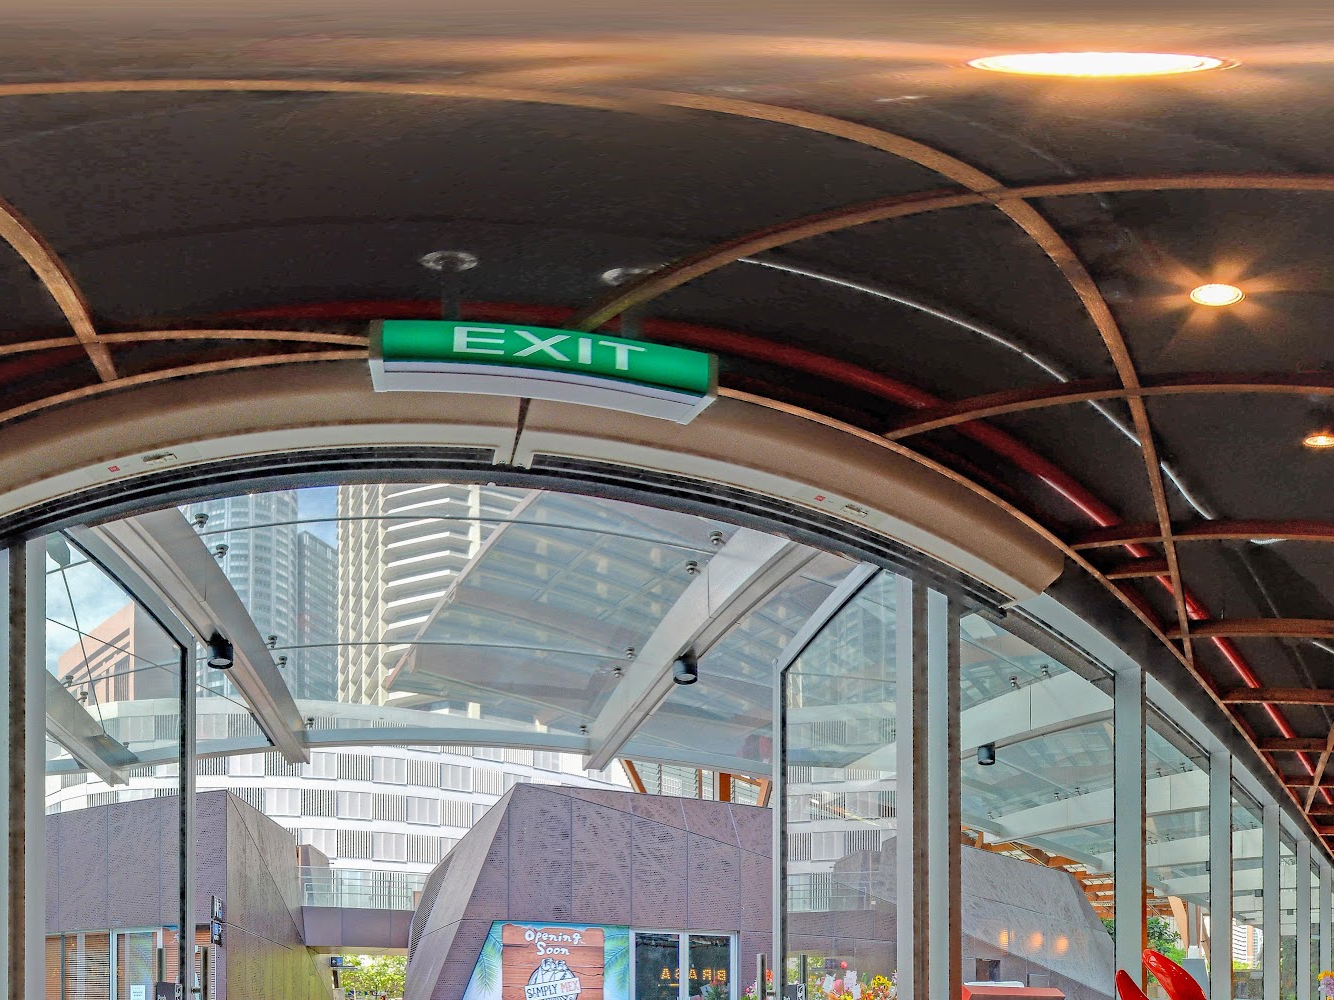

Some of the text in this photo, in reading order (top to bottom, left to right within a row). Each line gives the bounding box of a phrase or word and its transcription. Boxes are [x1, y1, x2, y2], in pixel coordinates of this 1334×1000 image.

[452, 326, 647, 371] EXIT
[524, 929, 586, 944] Opening
[536, 941, 570, 956] Soon
[526, 980, 580, 999] SIMPLY MEX
